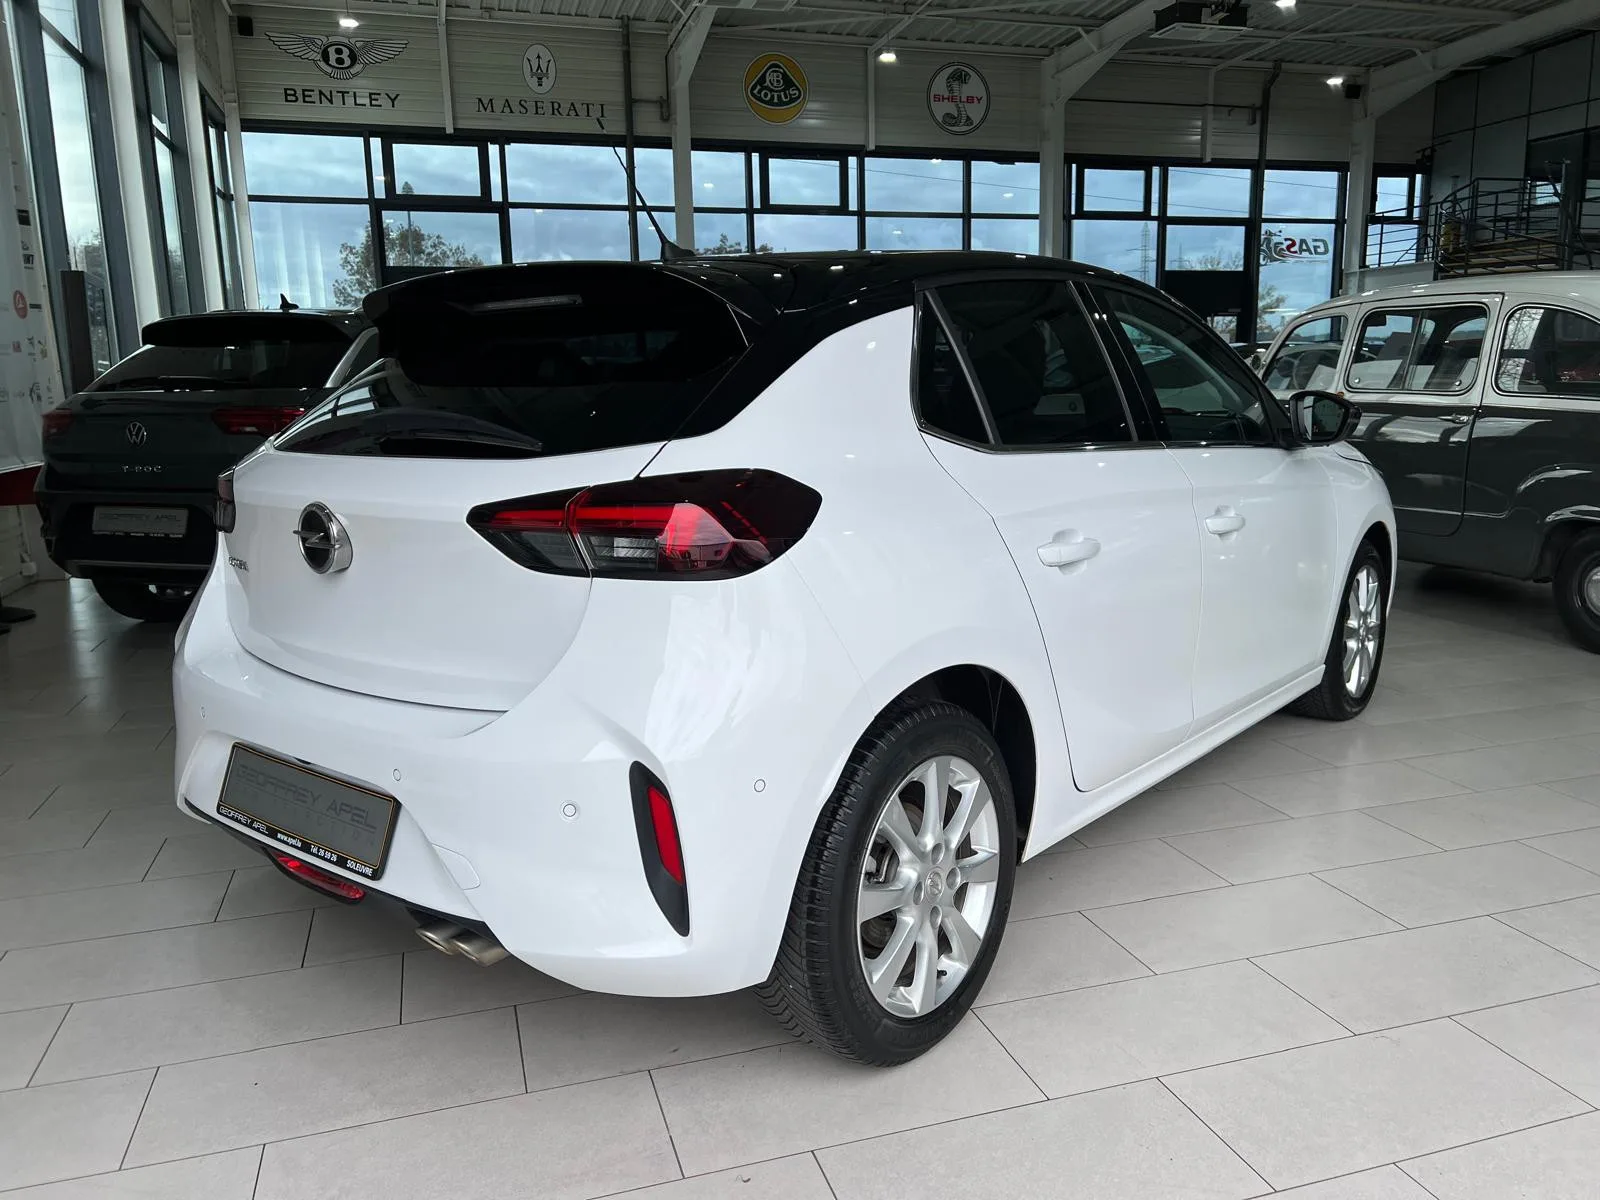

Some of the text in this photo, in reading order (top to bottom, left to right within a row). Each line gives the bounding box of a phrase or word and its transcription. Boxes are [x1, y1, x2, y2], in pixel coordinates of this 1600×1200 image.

[283, 87, 401, 108] BENTLEY
[752, 84, 800, 103] LOTUS
[933, 94, 984, 104] SHELBY
[476, 97, 607, 118] MASERATI
[237, 765, 322, 804] GEOFFREY
[326, 799, 377, 828] APEL
[219, 806, 252, 825] GEOFFREY
[252, 821, 269, 834] APEL
[346, 859, 374, 877] SOLEUVRE
